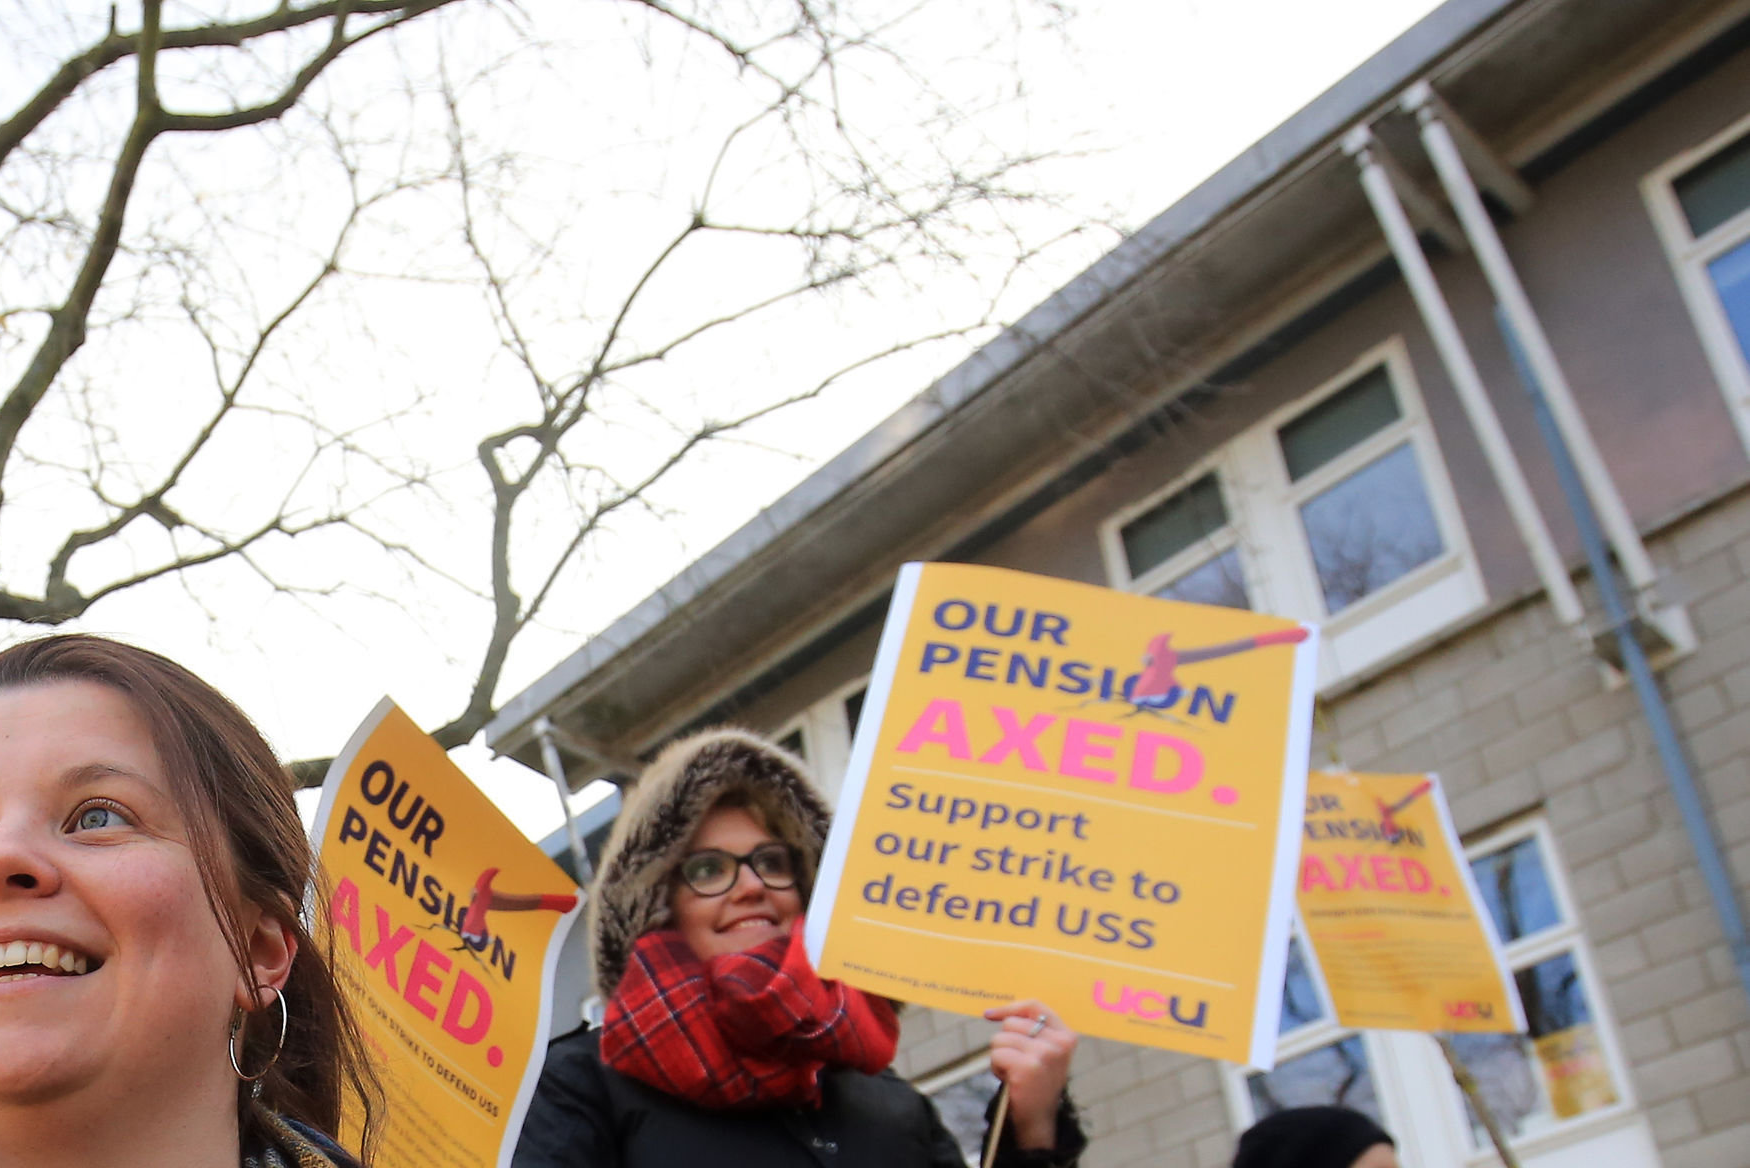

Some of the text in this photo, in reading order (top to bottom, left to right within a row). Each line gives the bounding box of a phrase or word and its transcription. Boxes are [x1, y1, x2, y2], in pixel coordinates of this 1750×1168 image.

[932, 599, 1071, 647] OUR
[919, 641, 1238, 725] PENSION
[896, 697, 1240, 807] AXED.
[360, 760, 445, 858] OUR
[886, 782, 1090, 840] Support
[1304, 817, 1427, 849] ENSION
[339, 806, 517, 983] PENSION
[874, 832, 1181, 905] our strike to
[1301, 853, 1452, 898] AXED.
[862, 874, 1158, 952] defend USS
[331, 876, 505, 1070] AXED.
[423, 1051, 436, 1069] TO
[436, 1064, 478, 1101] DEFEND
[479, 1094, 500, 1118] USS
